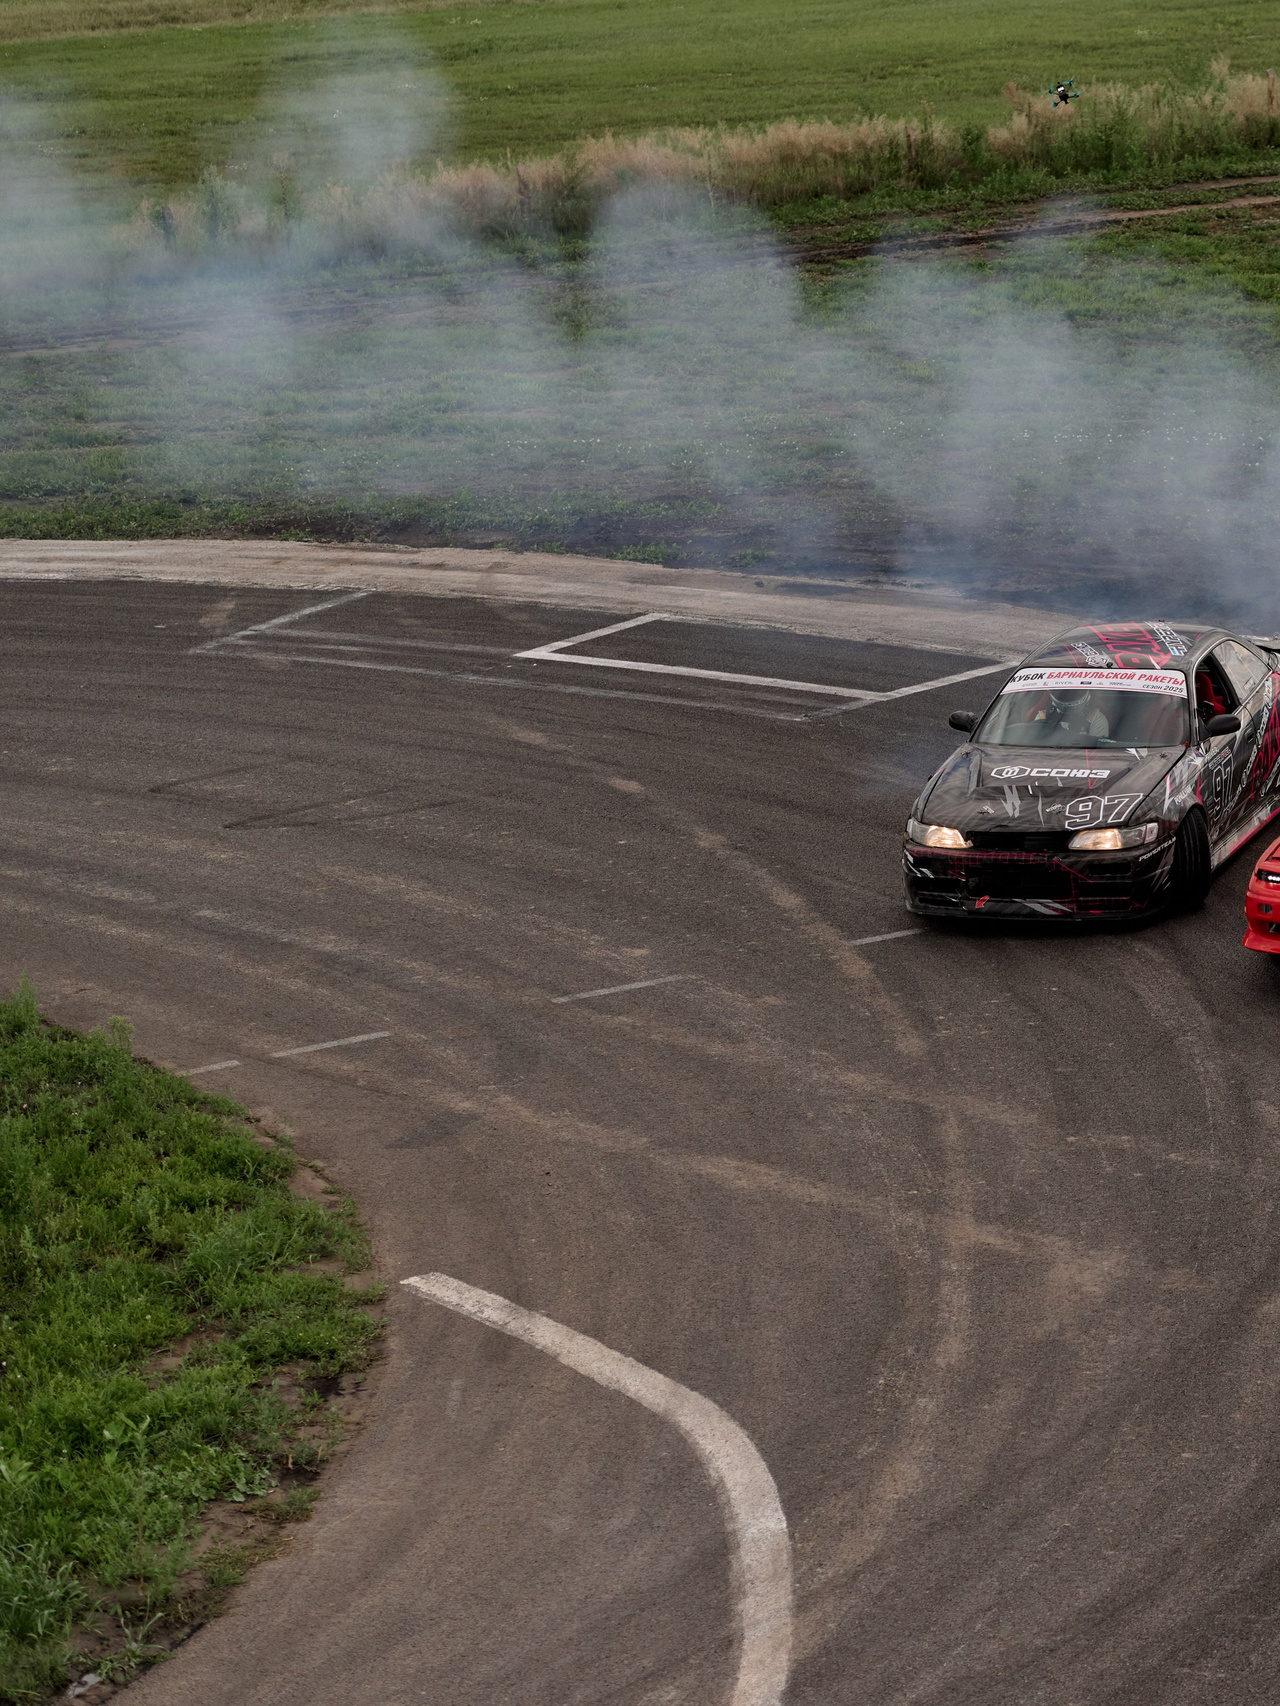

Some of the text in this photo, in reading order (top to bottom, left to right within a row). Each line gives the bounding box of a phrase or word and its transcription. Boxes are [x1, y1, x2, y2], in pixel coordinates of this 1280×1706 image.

[1010, 671, 1186, 686] КУБОК БАРНАУЛЬСКОЙ РАКЕТЫ
[1163, 685, 1184, 693] 2025
[1030, 768, 1110, 779] СОЮЗ
[1065, 793, 1143, 830] 97
